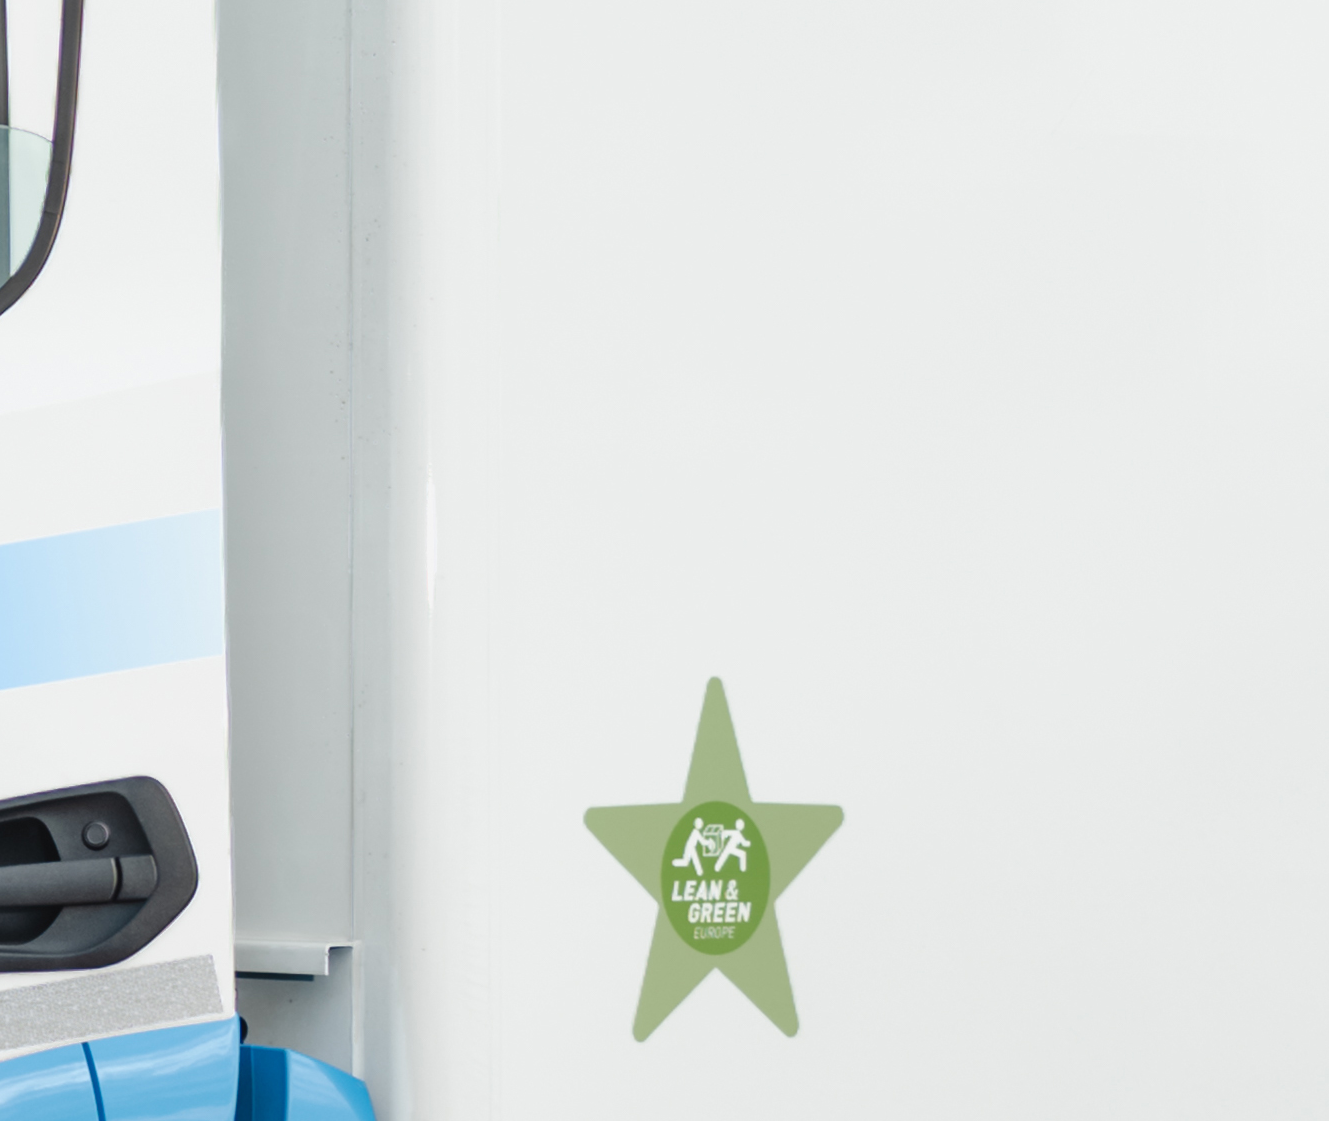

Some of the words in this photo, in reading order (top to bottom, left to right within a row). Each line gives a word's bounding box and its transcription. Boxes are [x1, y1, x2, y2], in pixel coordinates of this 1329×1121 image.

[671, 879, 723, 902] LEAN
[725, 879, 739, 901] &
[687, 901, 752, 924] GREEN
[693, 925, 736, 940] EUROPE
